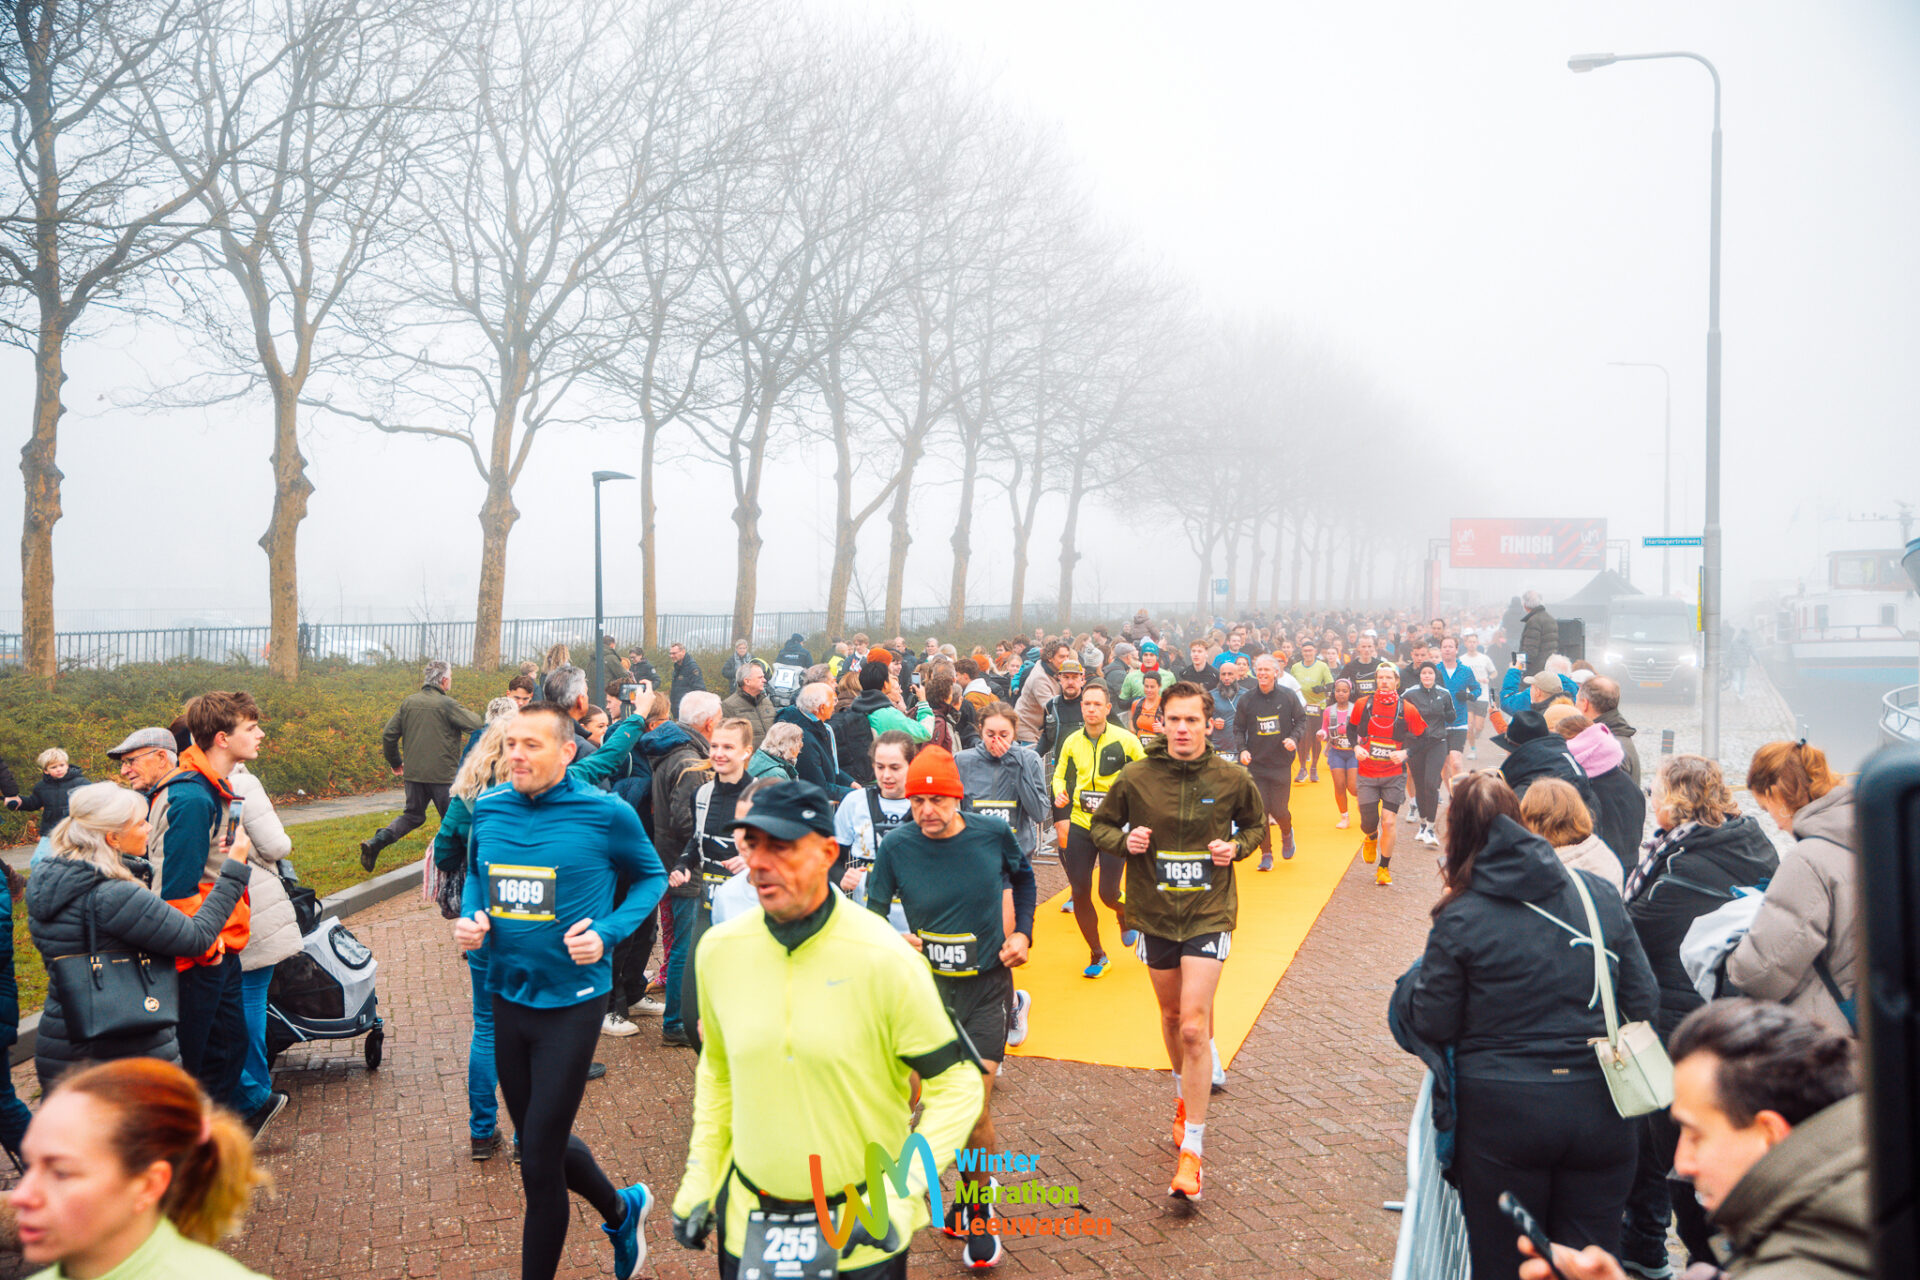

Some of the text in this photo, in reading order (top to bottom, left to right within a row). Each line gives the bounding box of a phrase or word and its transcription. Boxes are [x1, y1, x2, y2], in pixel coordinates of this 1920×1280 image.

[1500, 535, 1554, 555] FINISH
[1164, 861, 1203, 880] 1636
[497, 878, 545, 905] 1669
[926, 943, 967, 964] 1045
[762, 1226, 818, 1263] 255
